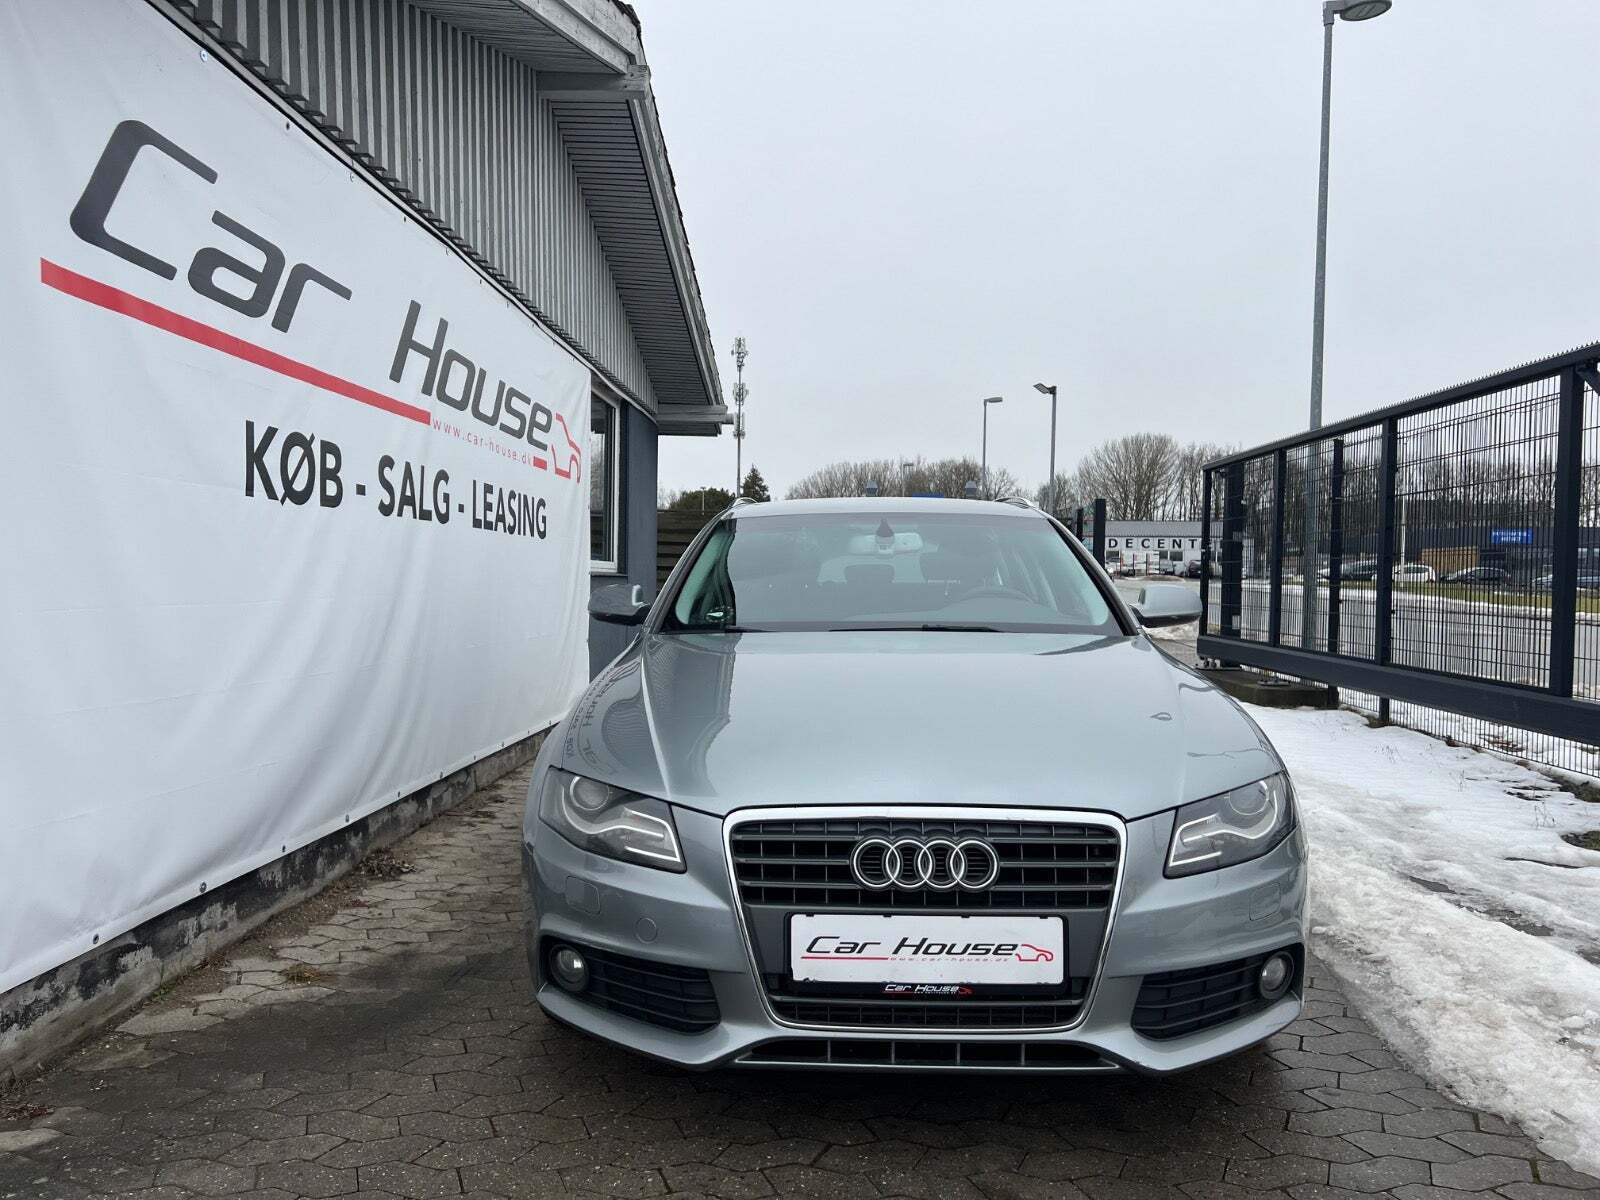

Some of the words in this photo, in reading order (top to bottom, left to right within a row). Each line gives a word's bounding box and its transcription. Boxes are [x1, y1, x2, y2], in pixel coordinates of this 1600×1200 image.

[69, 119, 352, 334] Car
[389, 299, 553, 452] House
[245, 420, 344, 508] KØB
[377, 454, 450, 525] SALG
[472, 479, 547, 540] LEASING
[1108, 538, 1212, 549] DECENT
[805, 935, 881, 954] Car
[891, 936, 1018, 956] House
[884, 983, 912, 992] Car
[914, 983, 960, 992] House
